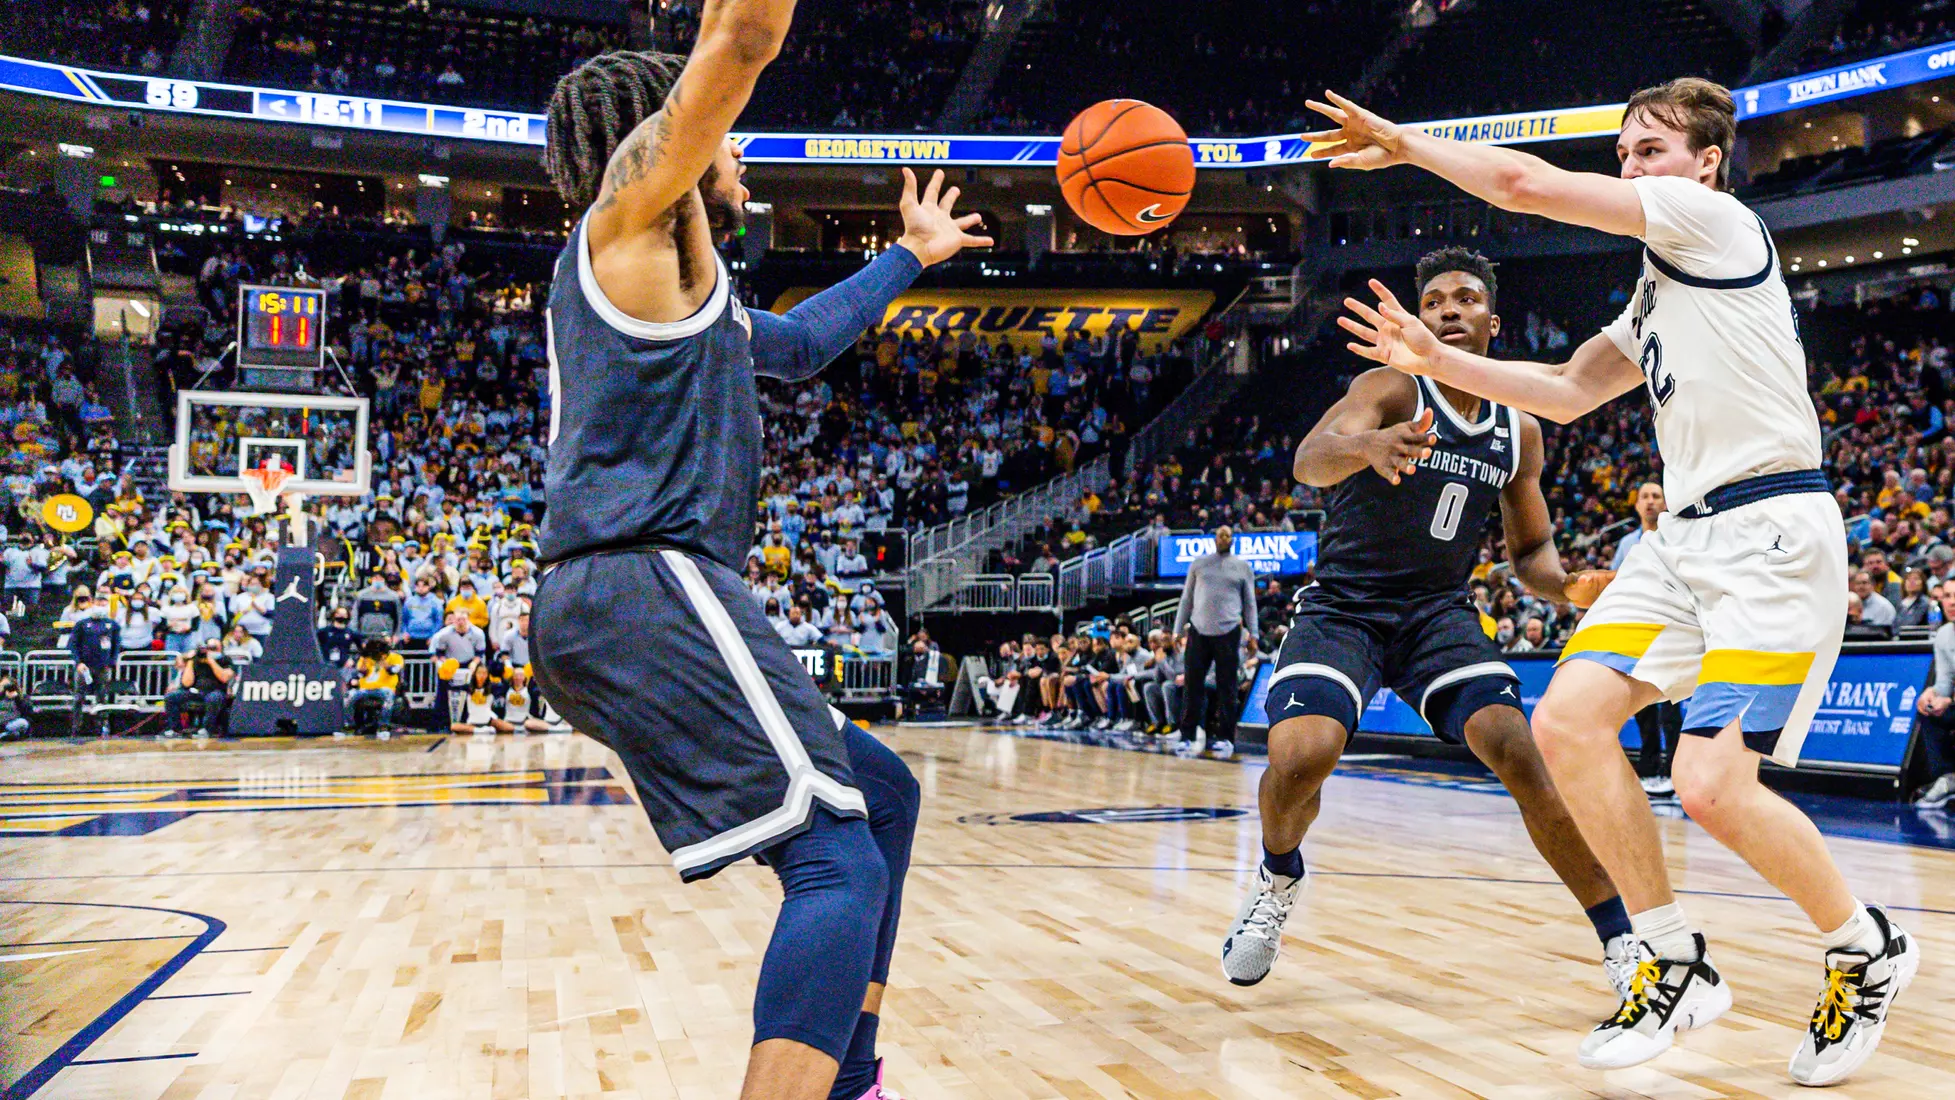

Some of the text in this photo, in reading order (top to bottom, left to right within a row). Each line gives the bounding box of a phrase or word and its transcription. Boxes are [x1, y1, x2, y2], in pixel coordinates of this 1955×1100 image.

[146, 80, 199, 109] 59
[1788, 62, 1888, 100] TOWN BANK
[296, 96, 383, 127] 15:11
[463, 112, 529, 139] 2nd
[805, 139, 950, 159] GEORGETOWN
[1198, 140, 1281, 162] TOL 2
[260, 293, 315, 314] 15:11
[272, 316, 308, 346] 11
[1430, 482, 1469, 541] 0
[1239, 536, 1299, 559] BANK
[242, 674, 336, 707] meijer
[1836, 682, 1898, 718] BANK
